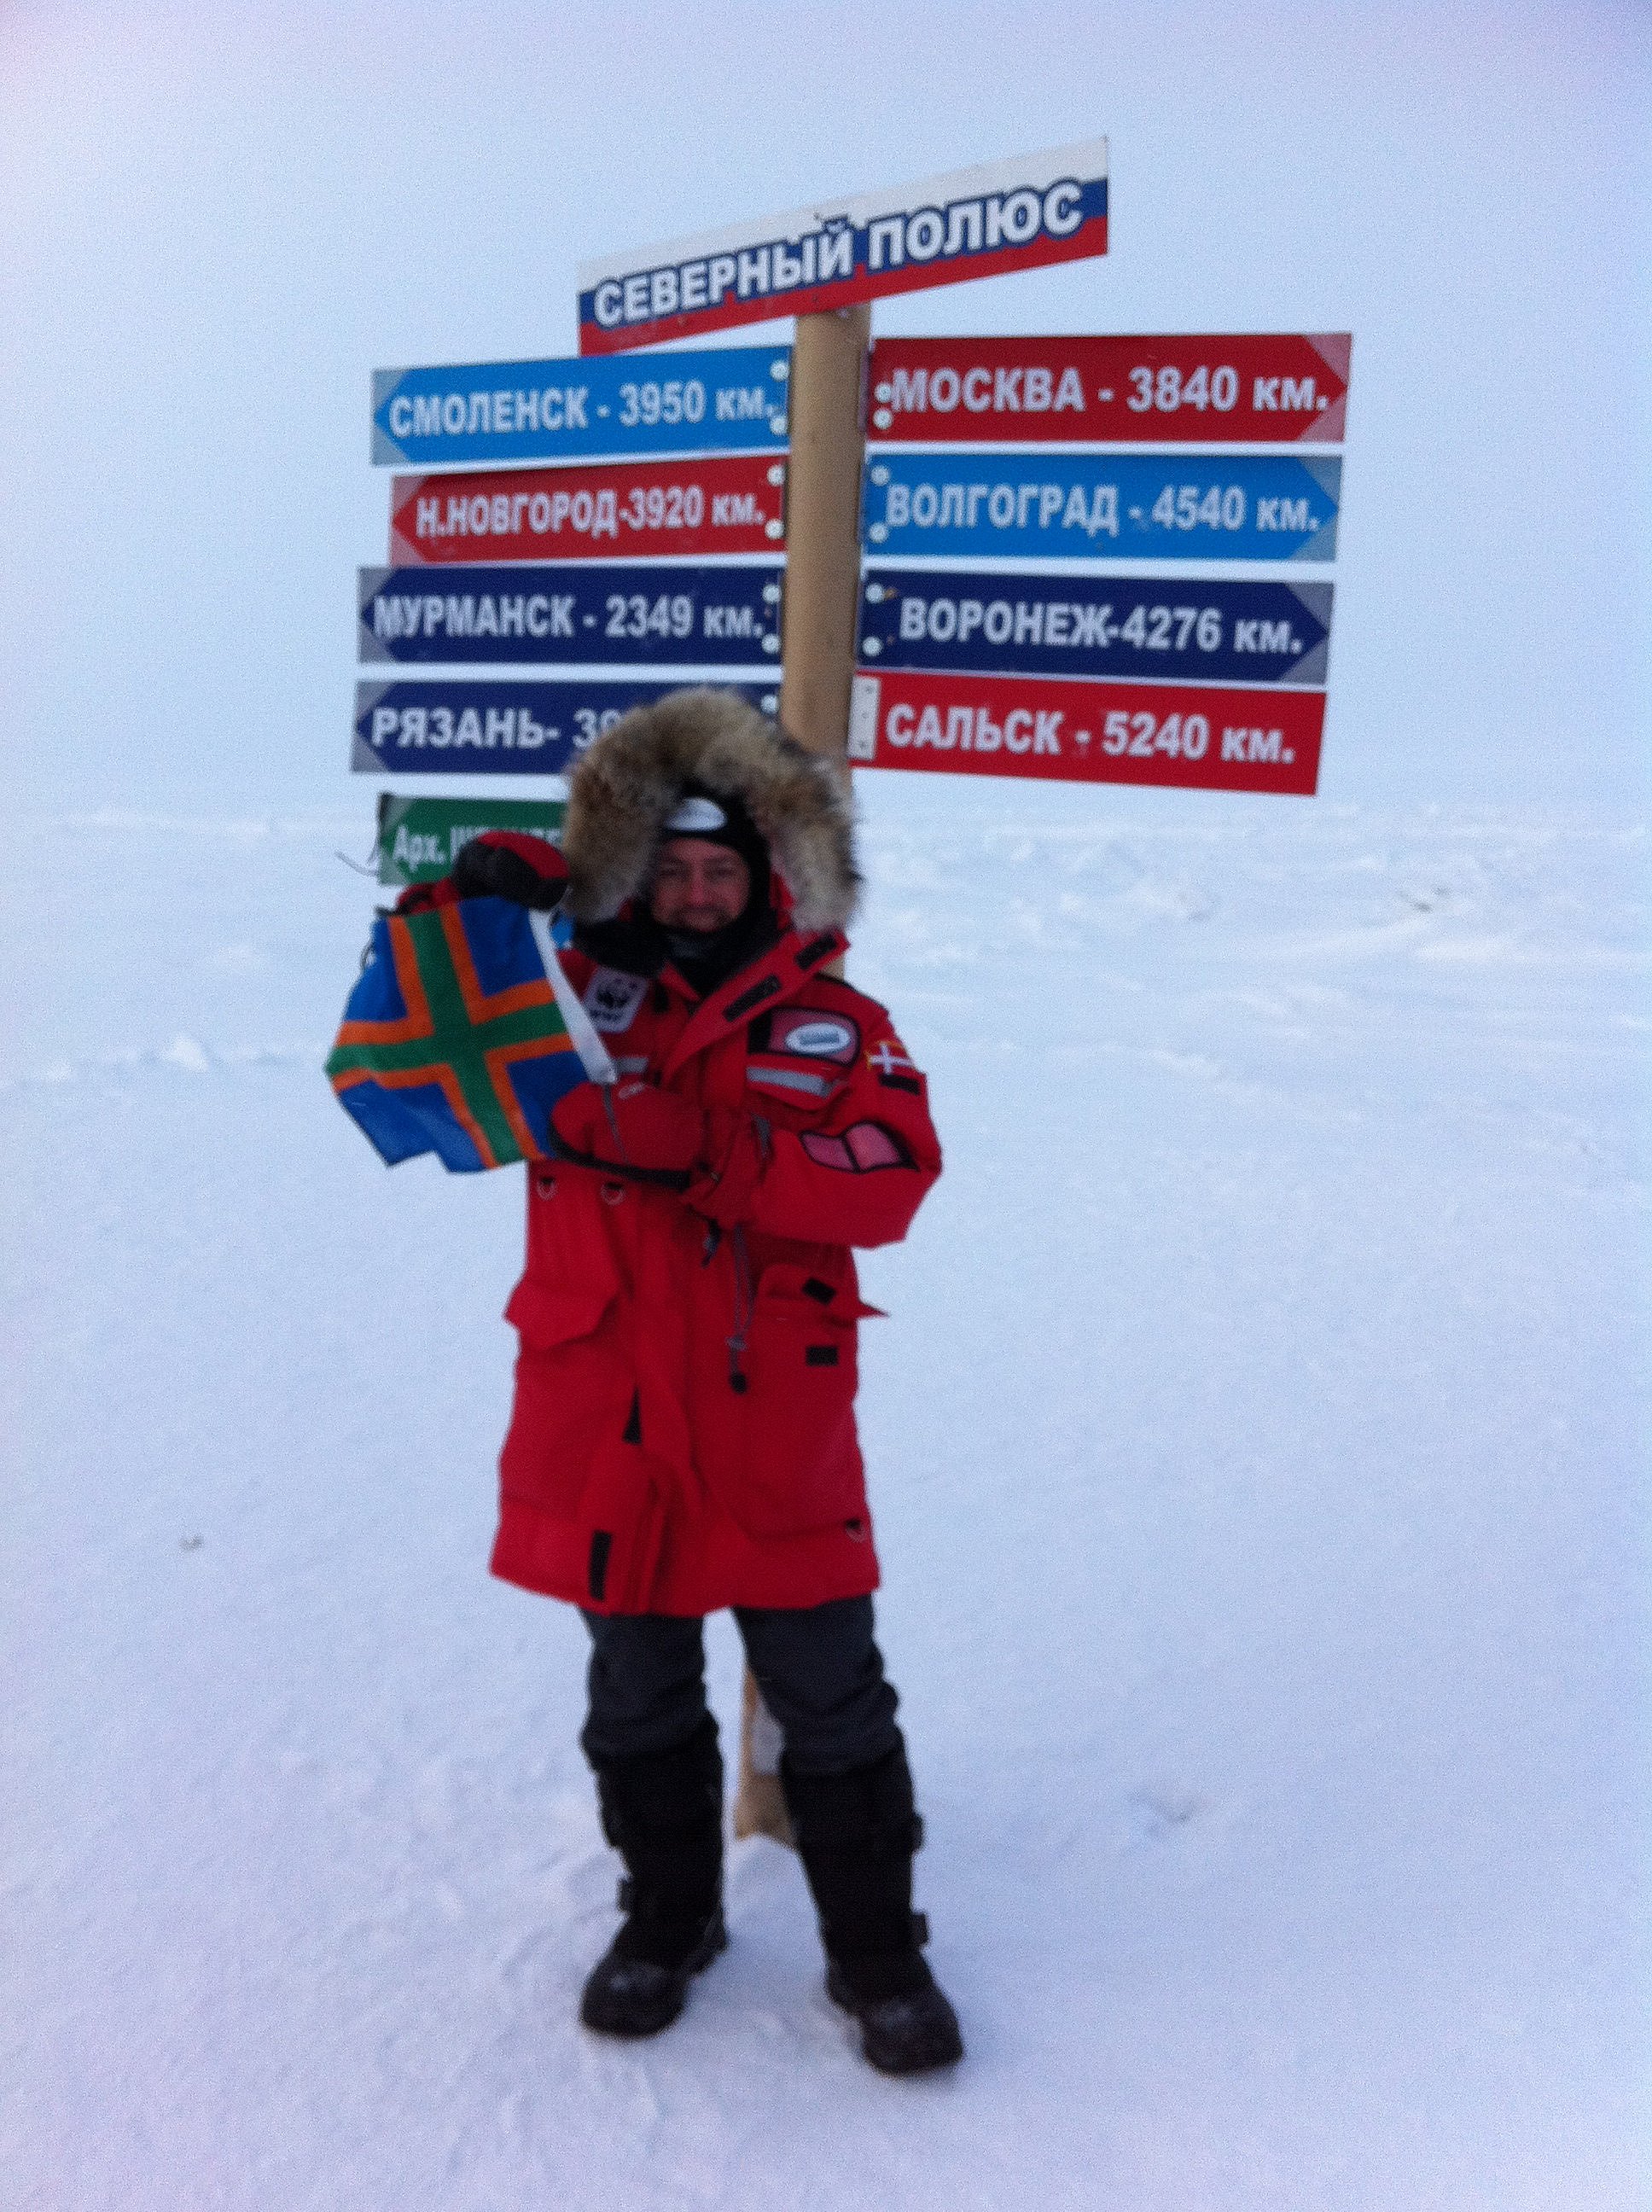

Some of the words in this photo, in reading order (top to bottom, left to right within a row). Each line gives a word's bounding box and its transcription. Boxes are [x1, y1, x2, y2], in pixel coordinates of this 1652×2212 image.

[594, 218, 853, 327] СЕВЕРНЫЙ
[867, 178, 1085, 270] ПОЛЮС
[389, 387, 589, 437] СМОЛЕНСК
[620, 381, 706, 426] 3950
[714, 385, 775, 422] км.
[890, 367, 1085, 413] МОСКВА
[1127, 365, 1239, 412] 3840
[1253, 376, 1329, 411] км.
[712, 492, 765, 526] км.
[885, 482, 1120, 538] ВОЛГОГРАД
[1151, 484, 1246, 532] 4540
[1256, 497, 1322, 532] км.
[372, 595, 575, 638] МУРМАНСК
[604, 594, 694, 637] 2349
[703, 605, 765, 638] км.
[1233, 618, 1304, 655] км.
[885, 703, 1063, 755] САЛЬСК
[1102, 709, 1209, 761] 5240
[1219, 725, 1295, 765] км.
